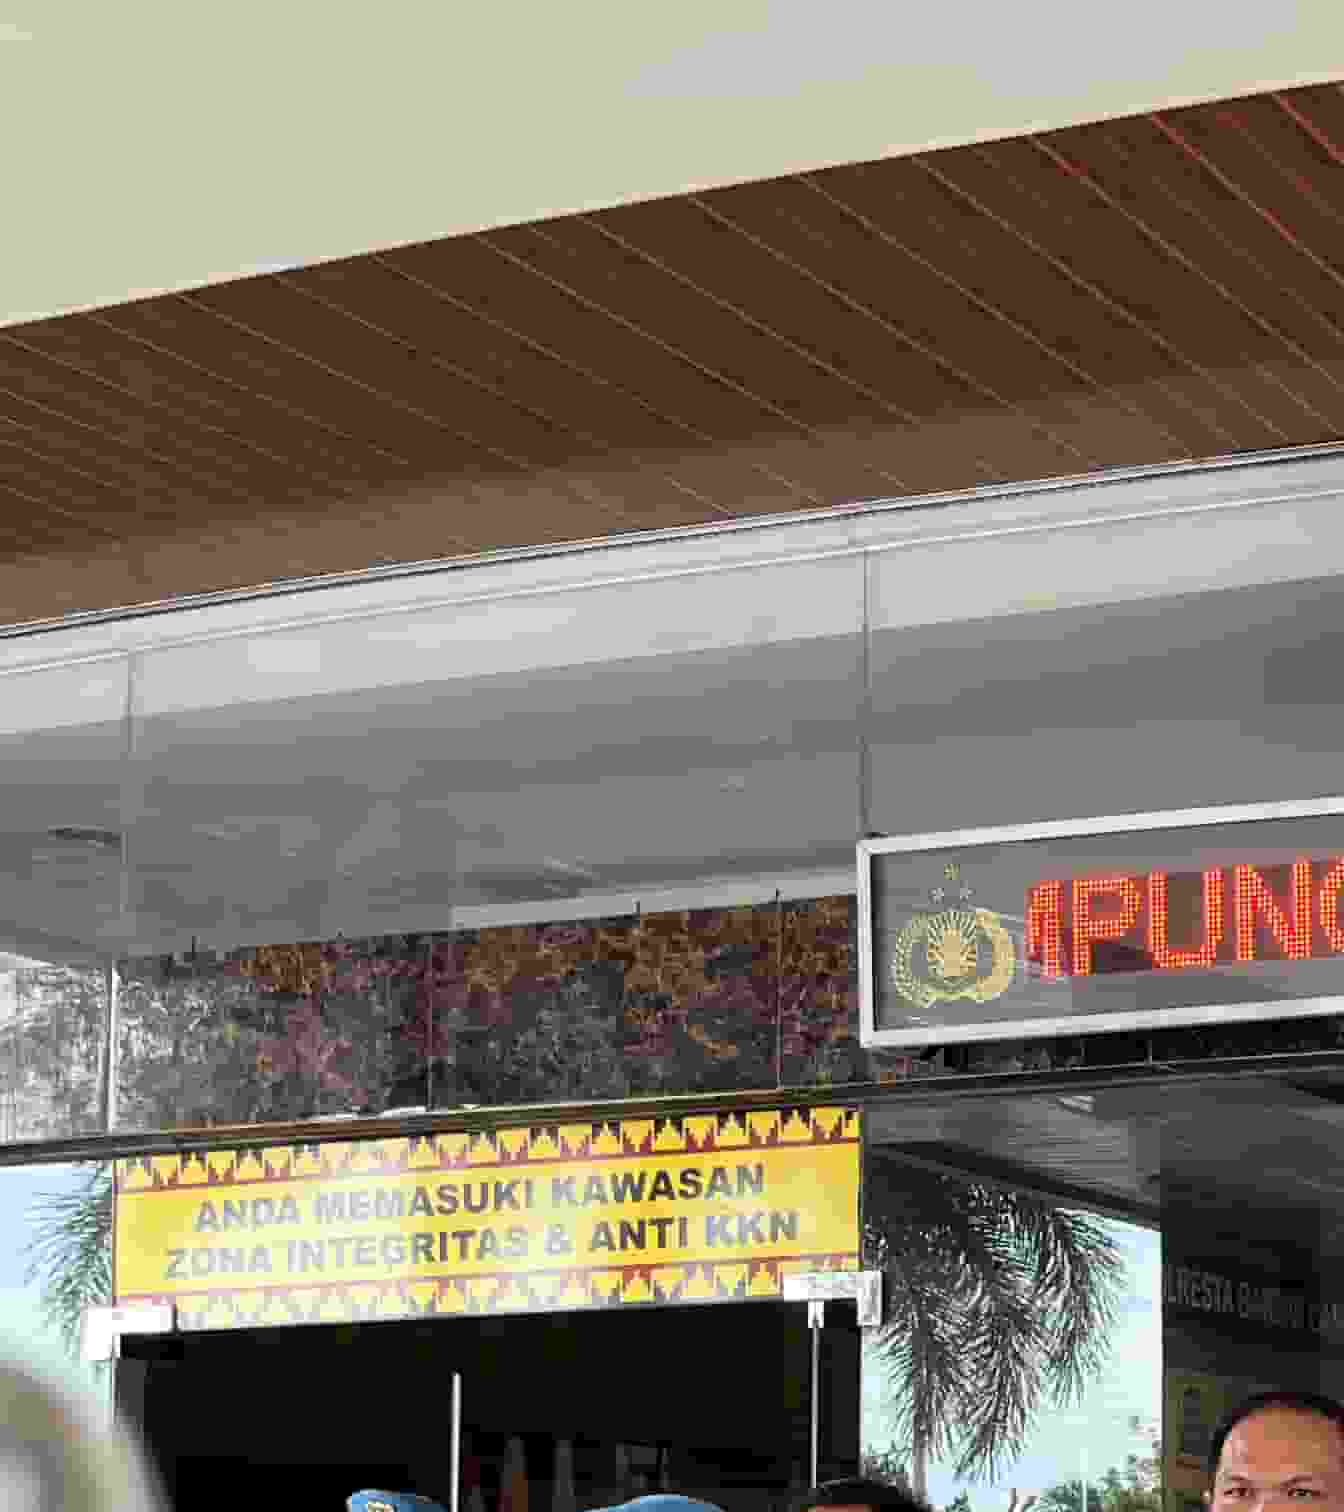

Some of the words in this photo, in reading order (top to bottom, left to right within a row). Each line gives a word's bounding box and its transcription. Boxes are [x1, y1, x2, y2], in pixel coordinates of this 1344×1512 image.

[195, 1193, 301, 1233] ANDA
[312, 1177, 533, 1225] MEMASUKI
[551, 1163, 767, 1207] KAWASAN
[164, 1243, 273, 1281] ZONA
[287, 1223, 529, 1274] INTEGRITAS
[543, 1222, 575, 1257] &
[588, 1216, 689, 1251] ANTI
[704, 1208, 798, 1247] KKN
